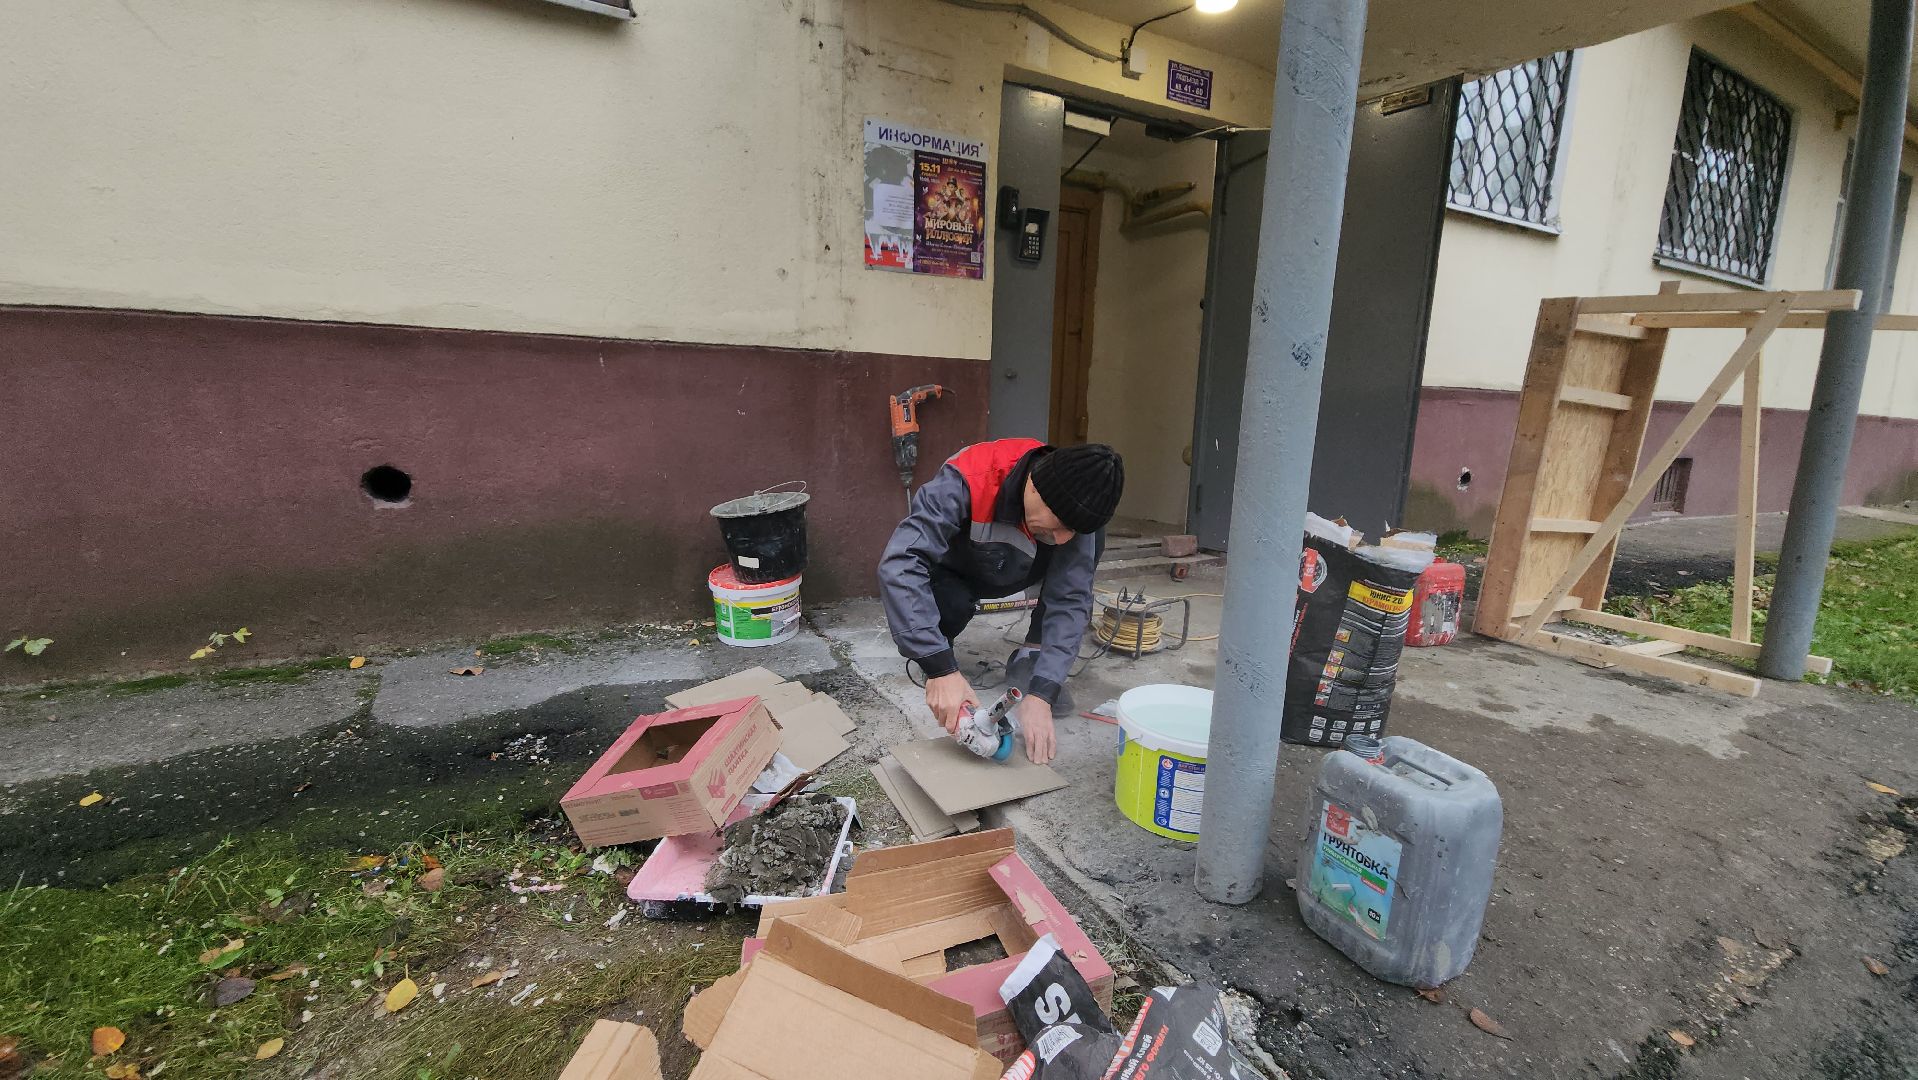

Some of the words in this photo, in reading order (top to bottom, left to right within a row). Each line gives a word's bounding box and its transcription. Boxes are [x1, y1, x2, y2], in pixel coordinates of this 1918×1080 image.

[1175, 72, 1200, 85] ПОДЪЕЗД
[1183, 84, 1191, 93] 41
[878, 126, 980, 157] ИНФОРМАЦИЯ
[919, 161, 941, 174] 15.11
[924, 217, 974, 233] МИРОВЫЕ
